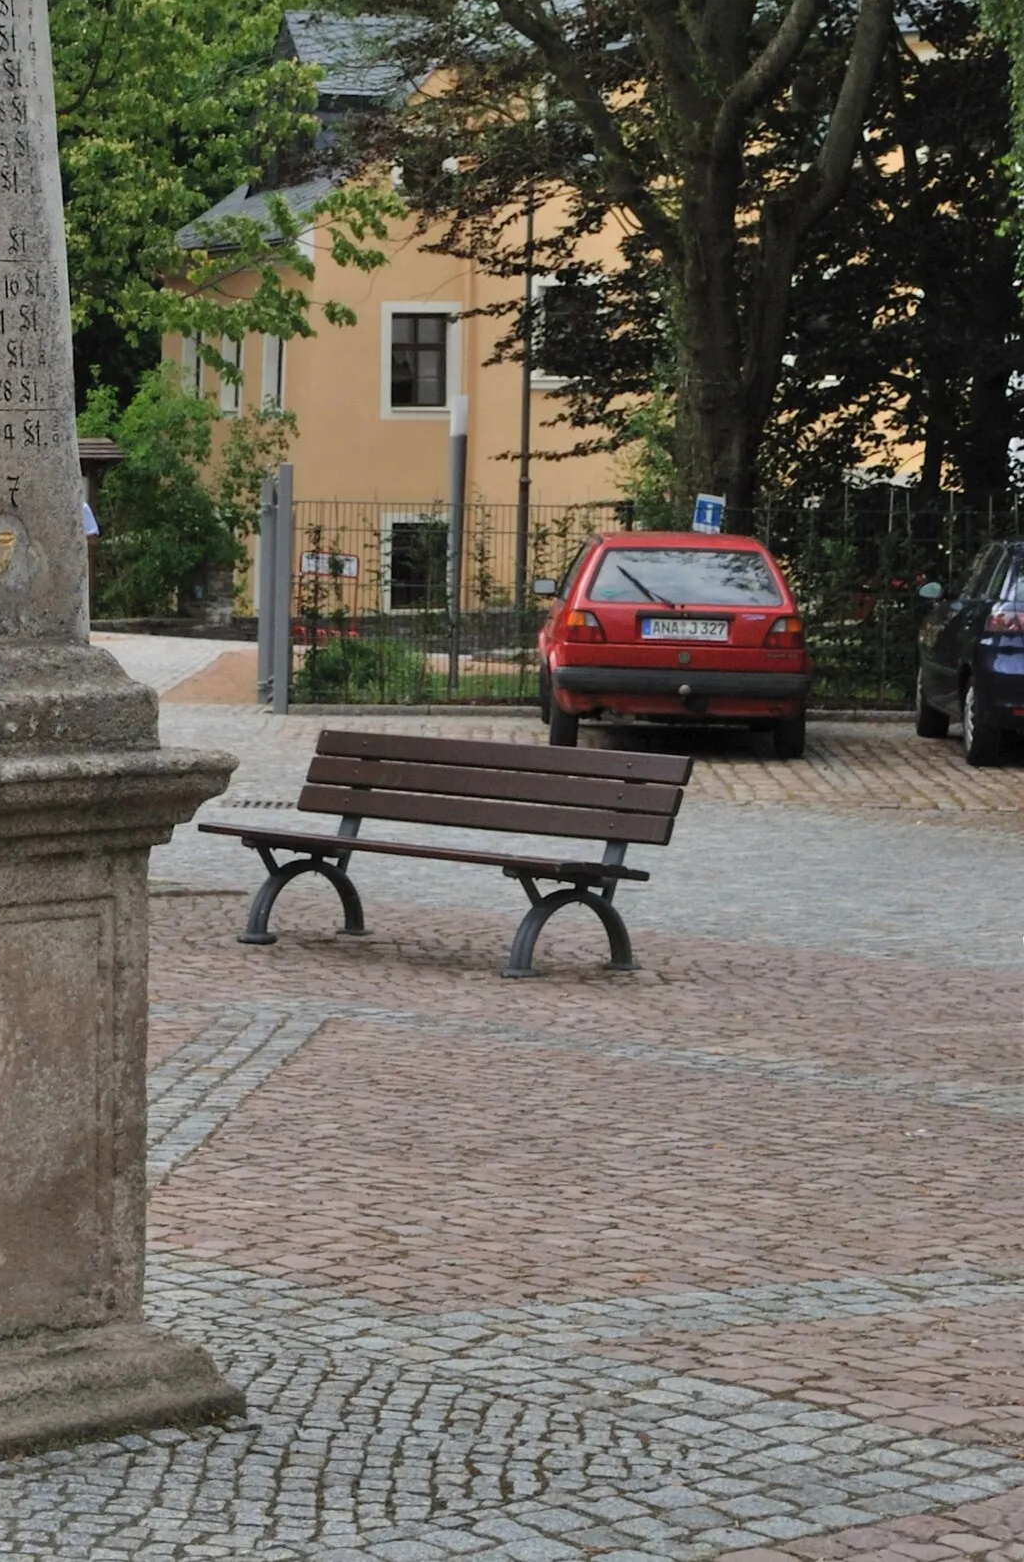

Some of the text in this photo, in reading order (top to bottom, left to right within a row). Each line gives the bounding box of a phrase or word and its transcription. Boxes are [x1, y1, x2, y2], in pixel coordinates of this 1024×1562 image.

[653, 621, 726, 636] ANA J 327
